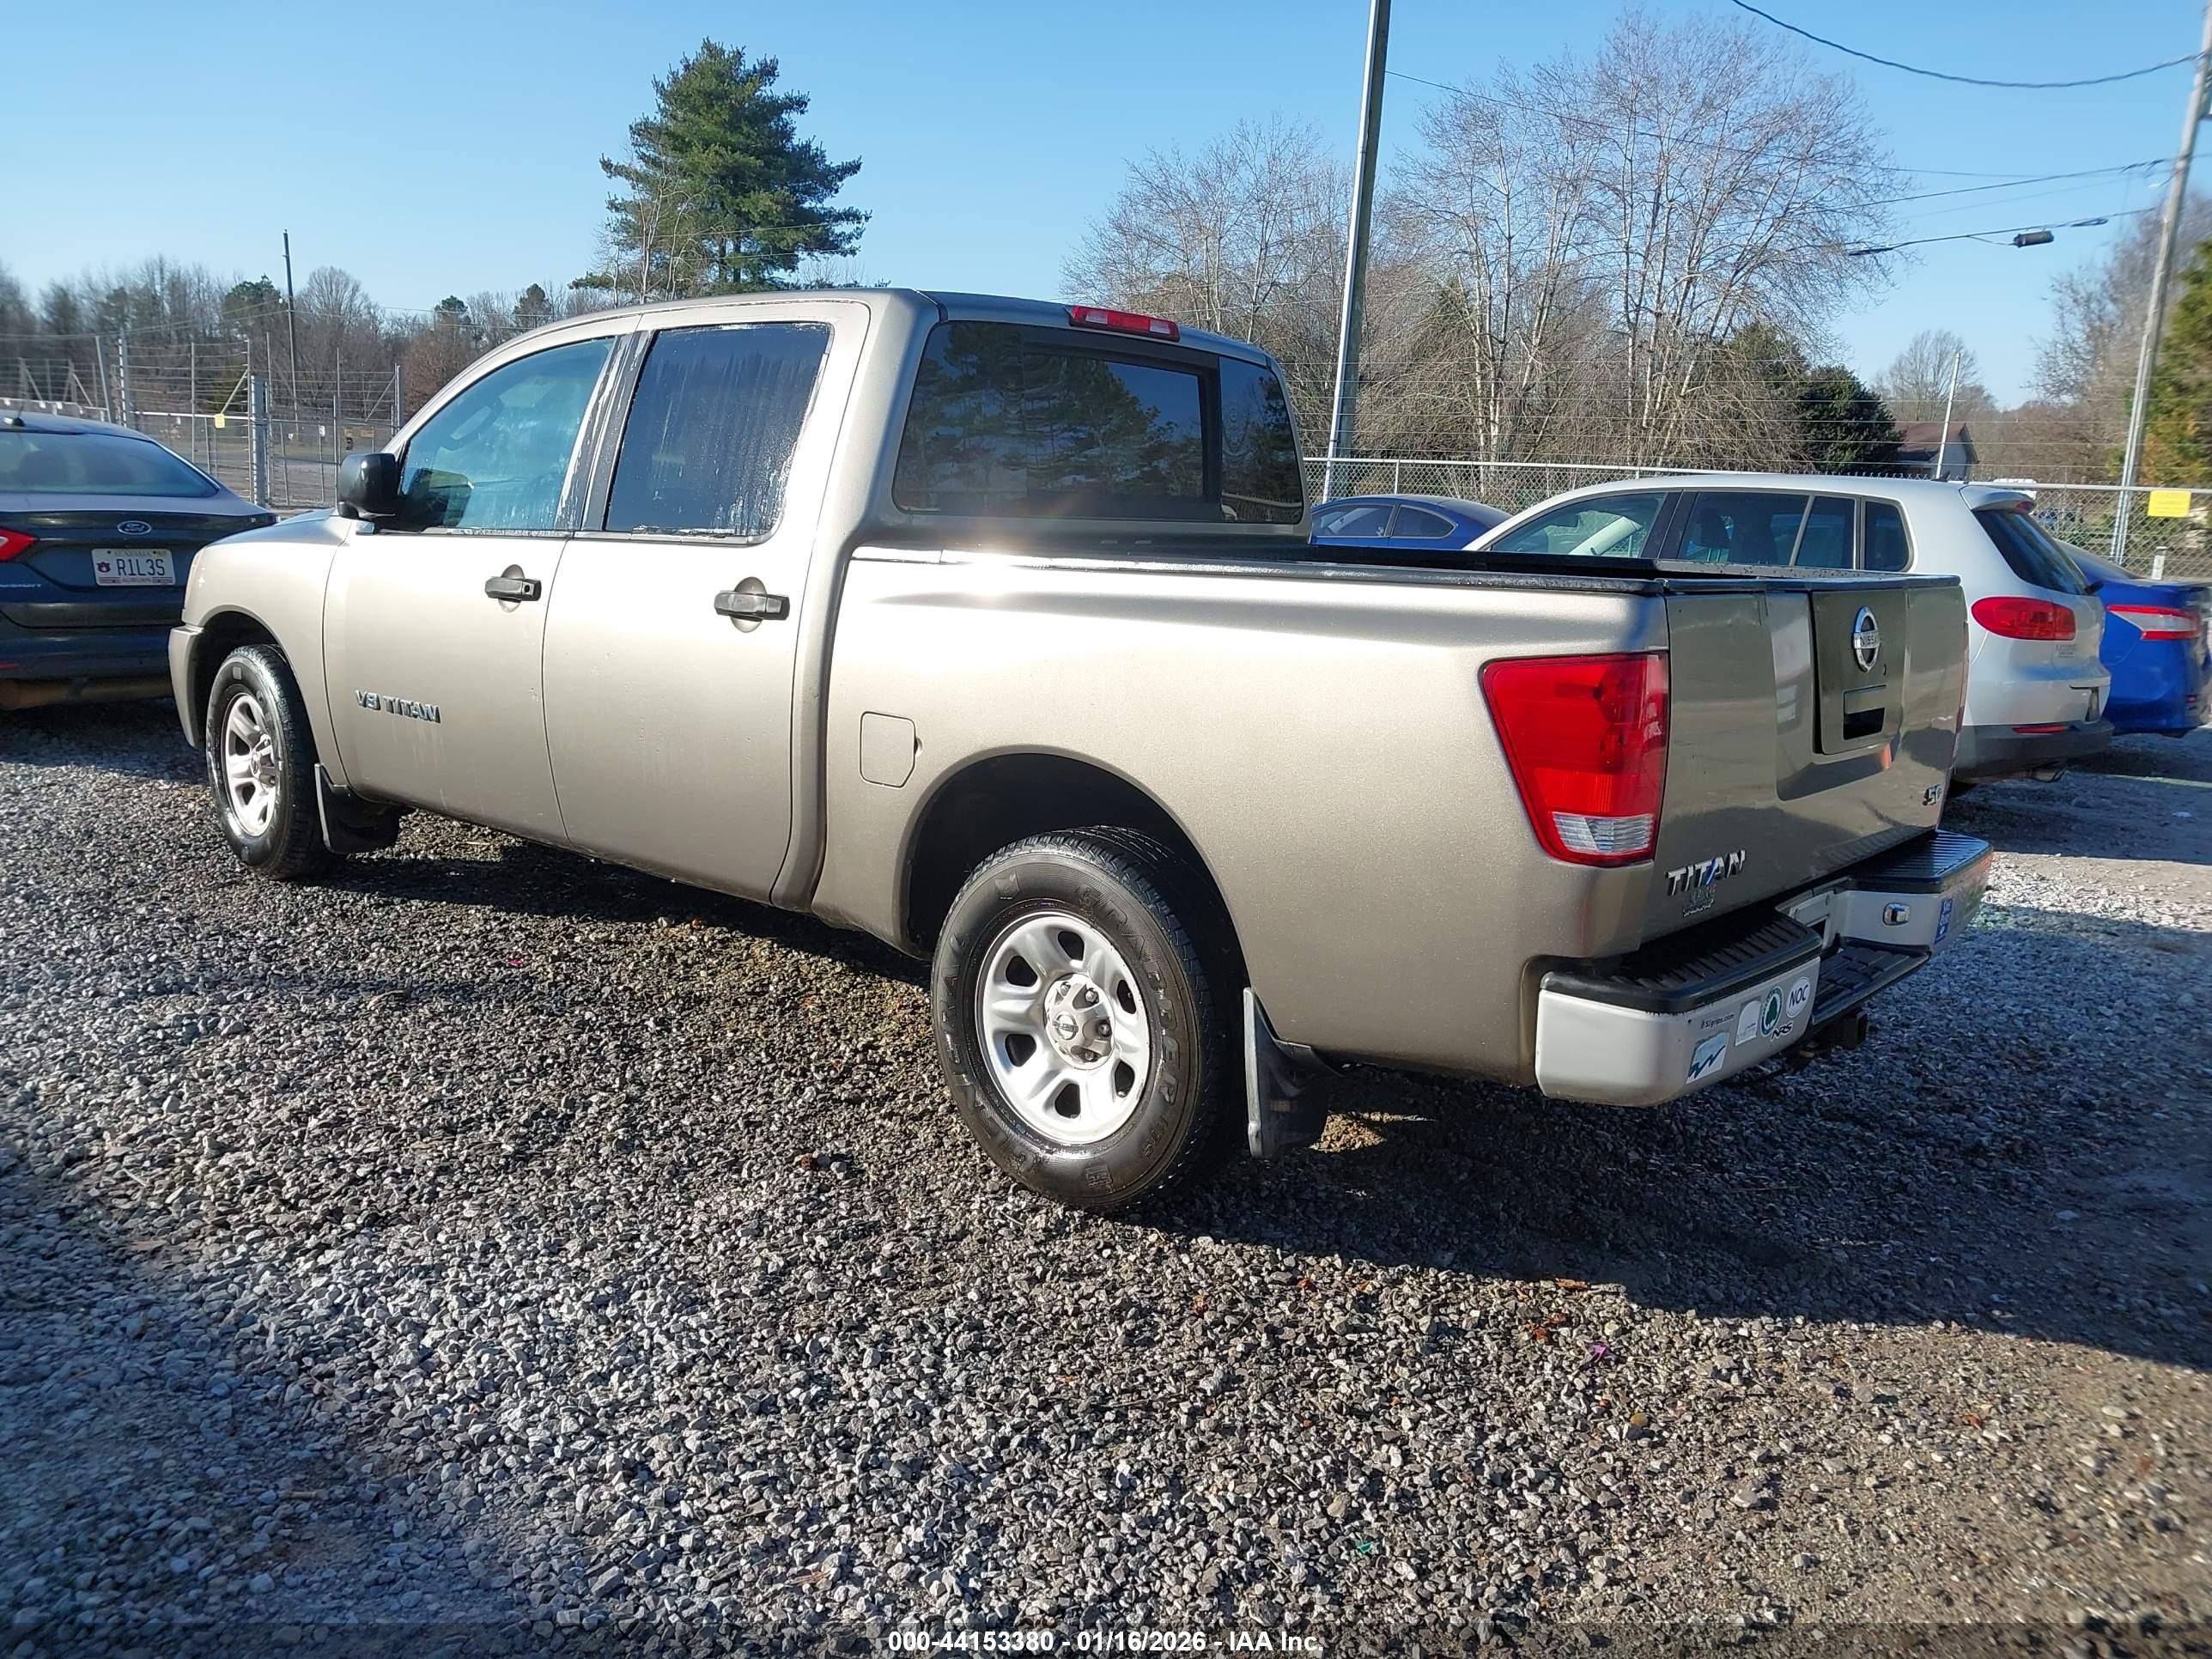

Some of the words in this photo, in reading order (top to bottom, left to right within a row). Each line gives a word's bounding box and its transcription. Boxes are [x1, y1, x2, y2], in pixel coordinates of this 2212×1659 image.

[116, 559, 166, 576] R1L3S
[356, 690, 381, 711] V8
[382, 696, 441, 724] TITAN
[1667, 849, 1747, 896] TITAN
[1789, 983, 1808, 1008] NOC
[1771, 1022, 1793, 1040] NRS
